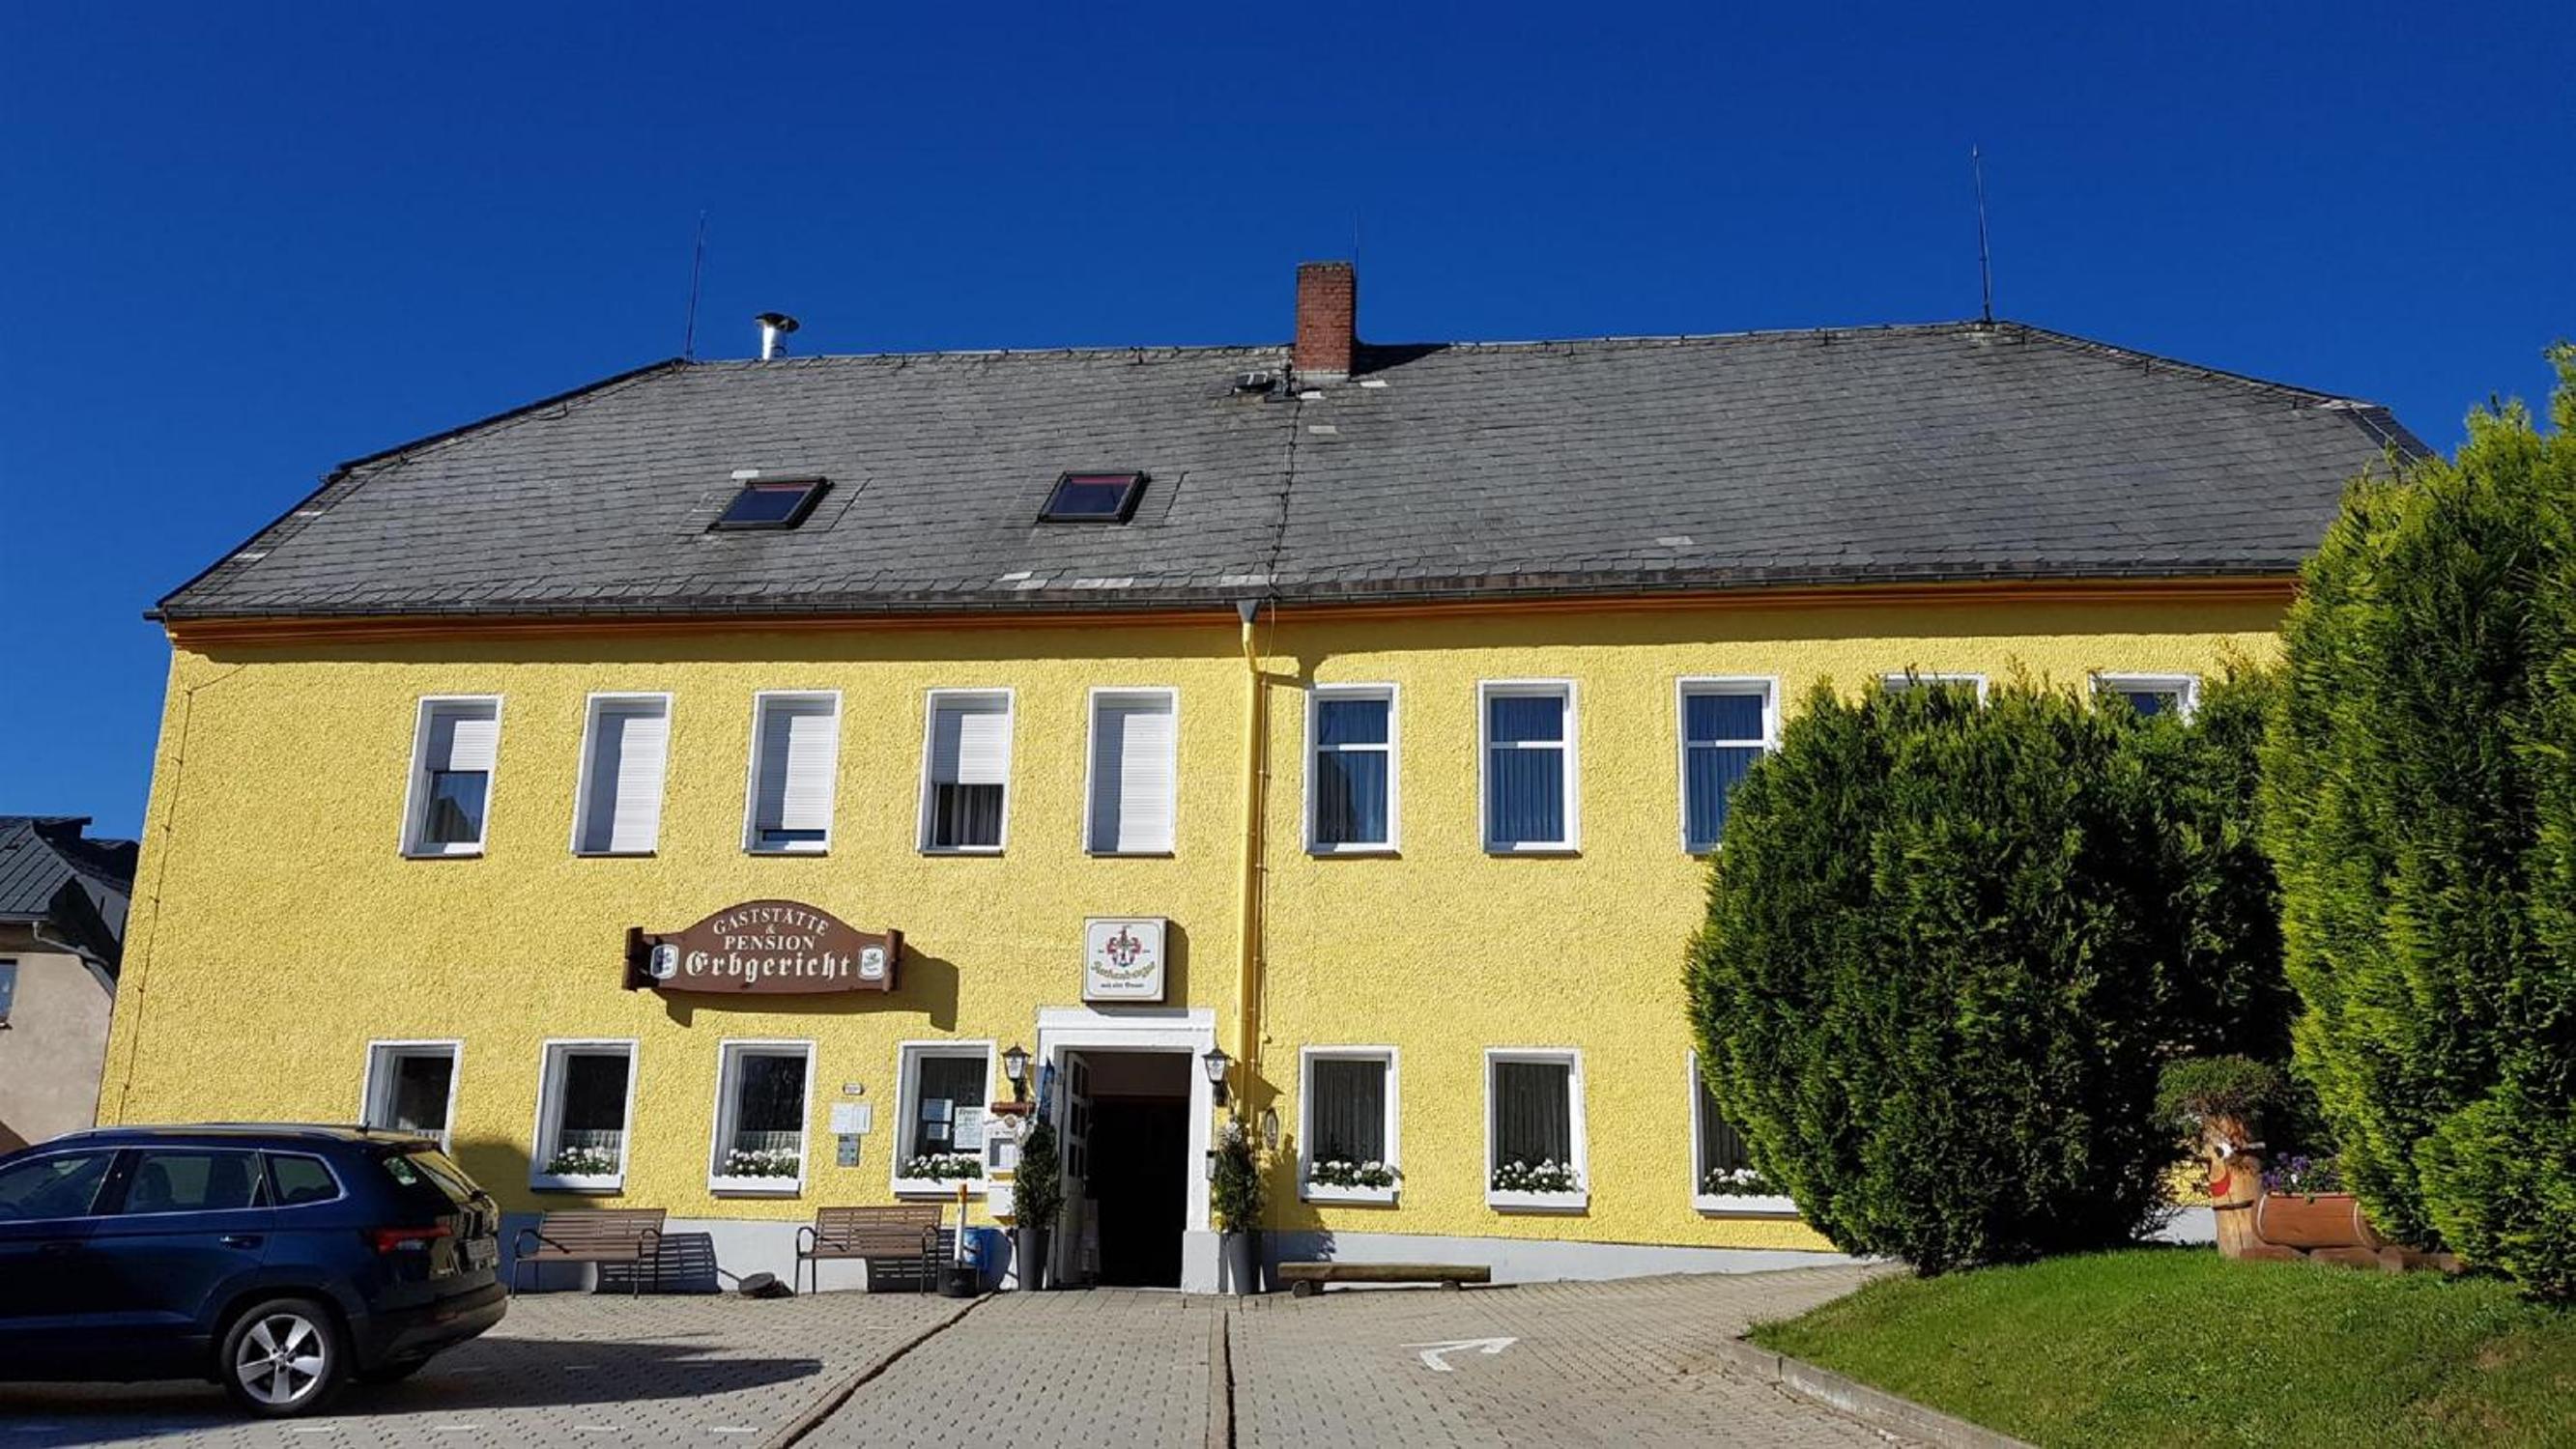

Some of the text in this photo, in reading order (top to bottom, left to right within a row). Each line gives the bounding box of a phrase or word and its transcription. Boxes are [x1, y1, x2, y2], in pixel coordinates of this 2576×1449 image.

[713, 907, 829, 936] GASTSTÄTTE
[765, 923, 776, 934] &
[724, 935, 816, 951] PENSION
[685, 950, 851, 983] Erbgericht
